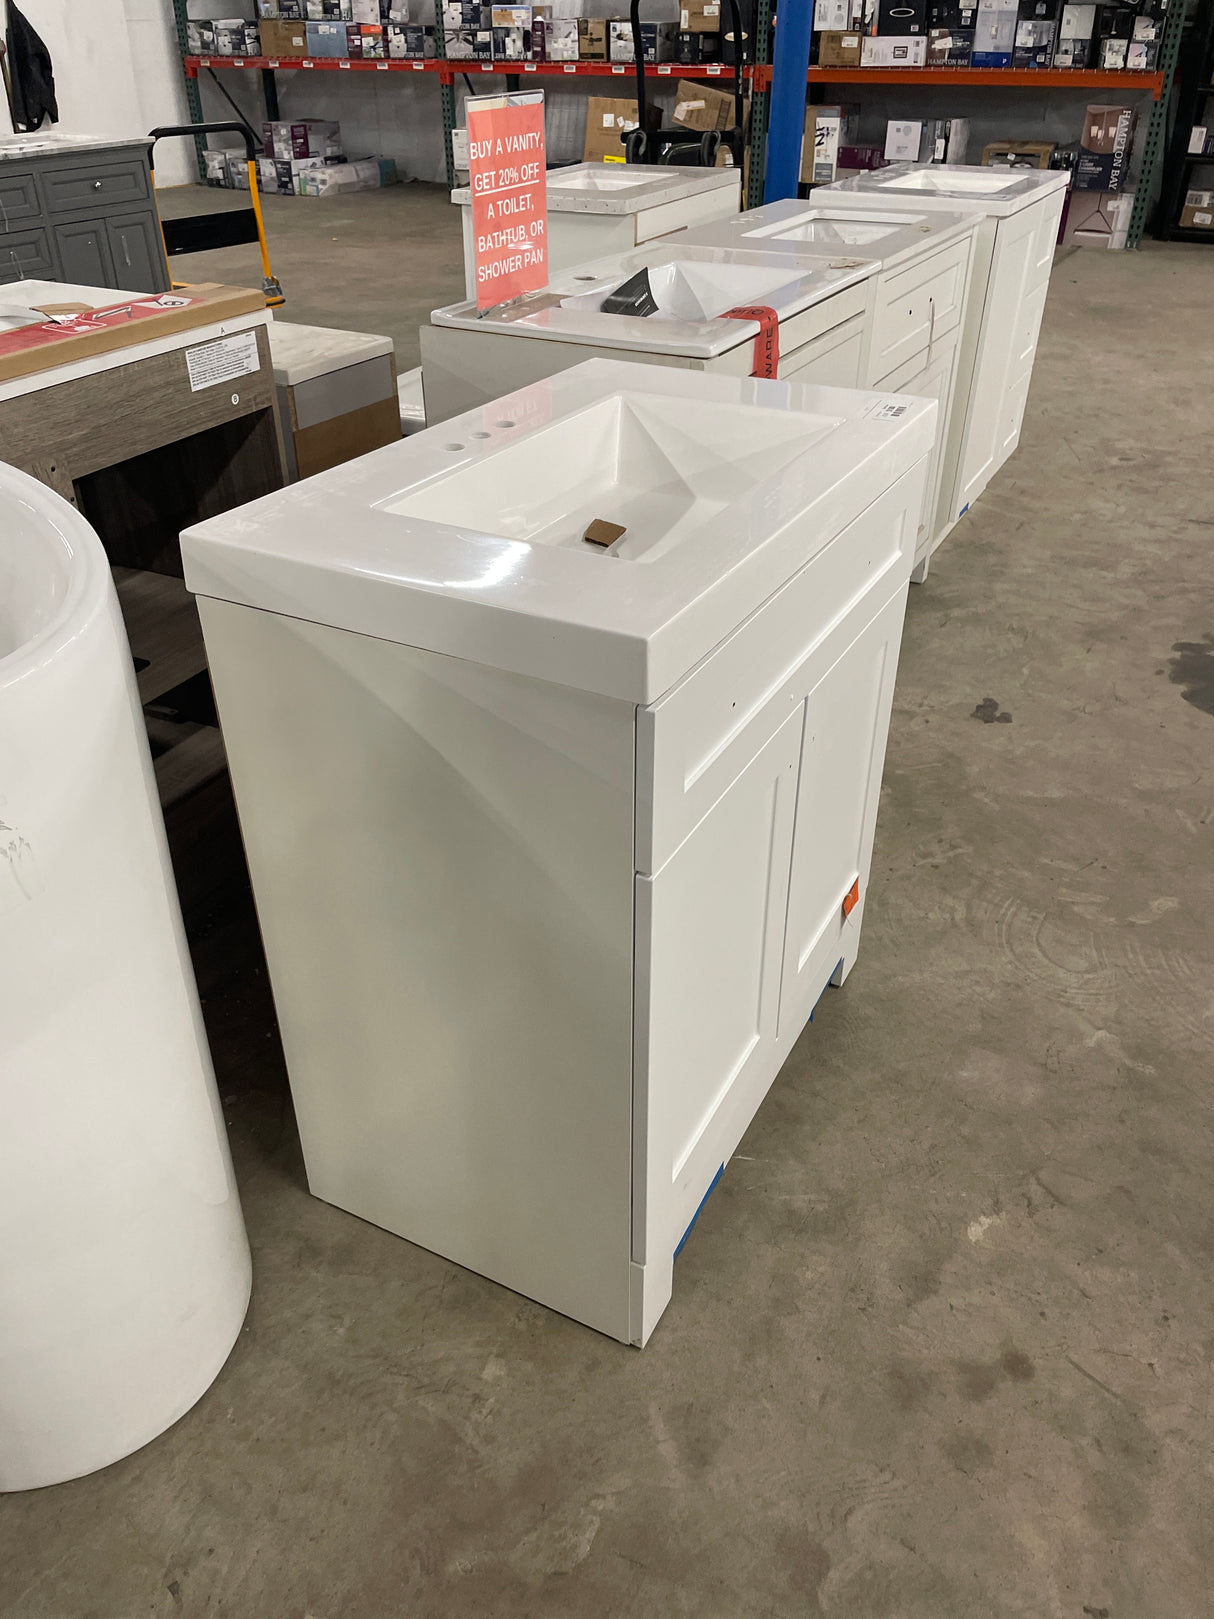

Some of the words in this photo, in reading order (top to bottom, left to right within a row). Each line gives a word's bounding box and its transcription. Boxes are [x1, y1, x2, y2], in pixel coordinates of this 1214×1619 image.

[470, 140, 492, 160] BUY
[496, 138, 504, 154] A
[505, 132, 543, 153] VANITY,
[1112, 110, 1132, 167] HAMPTON
[474, 171, 496, 191] GET
[498, 166, 519, 186] 20%
[521, 162, 540, 181] OFF
[1108, 169, 1120, 190] BAY
[487, 203, 495, 219] A
[496, 194, 534, 218] TOILET,
[530, 219, 544, 237] OR
[478, 255, 523, 282] SHOWER
[524, 247, 544, 267] PAN
